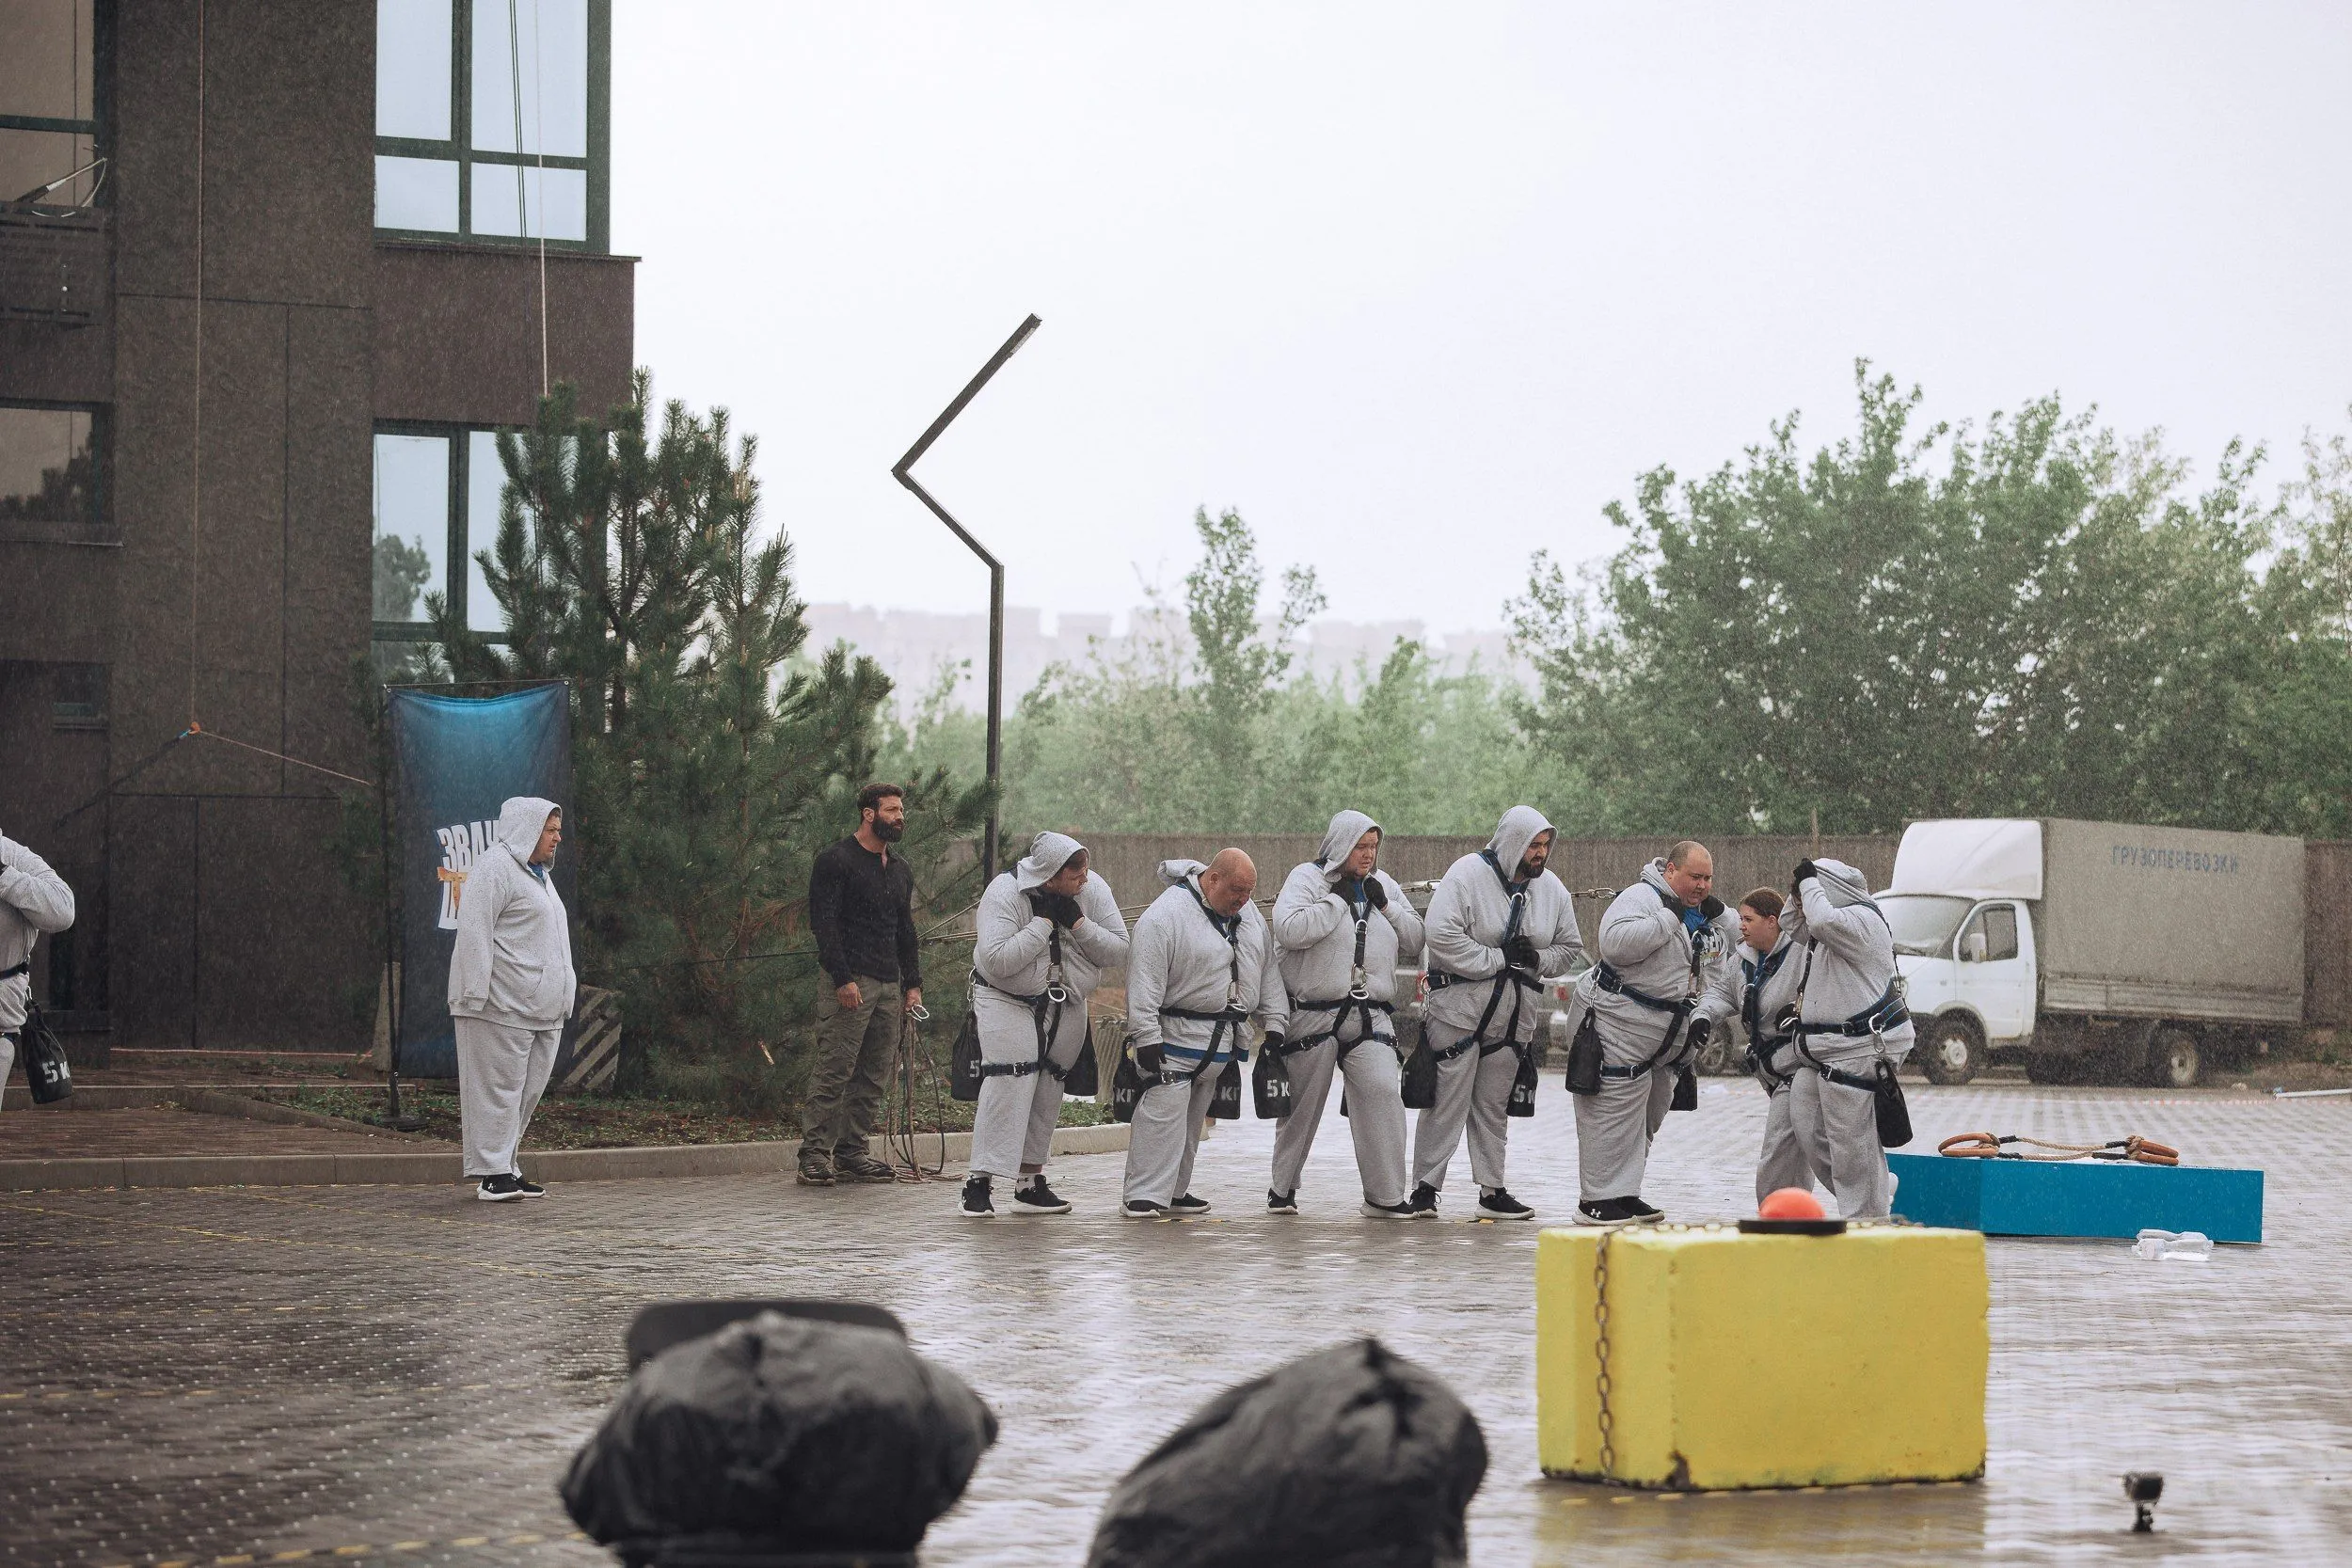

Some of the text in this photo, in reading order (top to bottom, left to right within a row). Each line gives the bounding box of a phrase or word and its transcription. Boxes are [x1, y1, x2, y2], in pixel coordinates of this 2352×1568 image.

[2111, 845, 2238, 874] ГРУЗОПЕРЕВОЗКИ
[41, 1060, 58, 1084] 5
[969, 1059, 980, 1078] 5
[1266, 1079, 1279, 1098] 5
